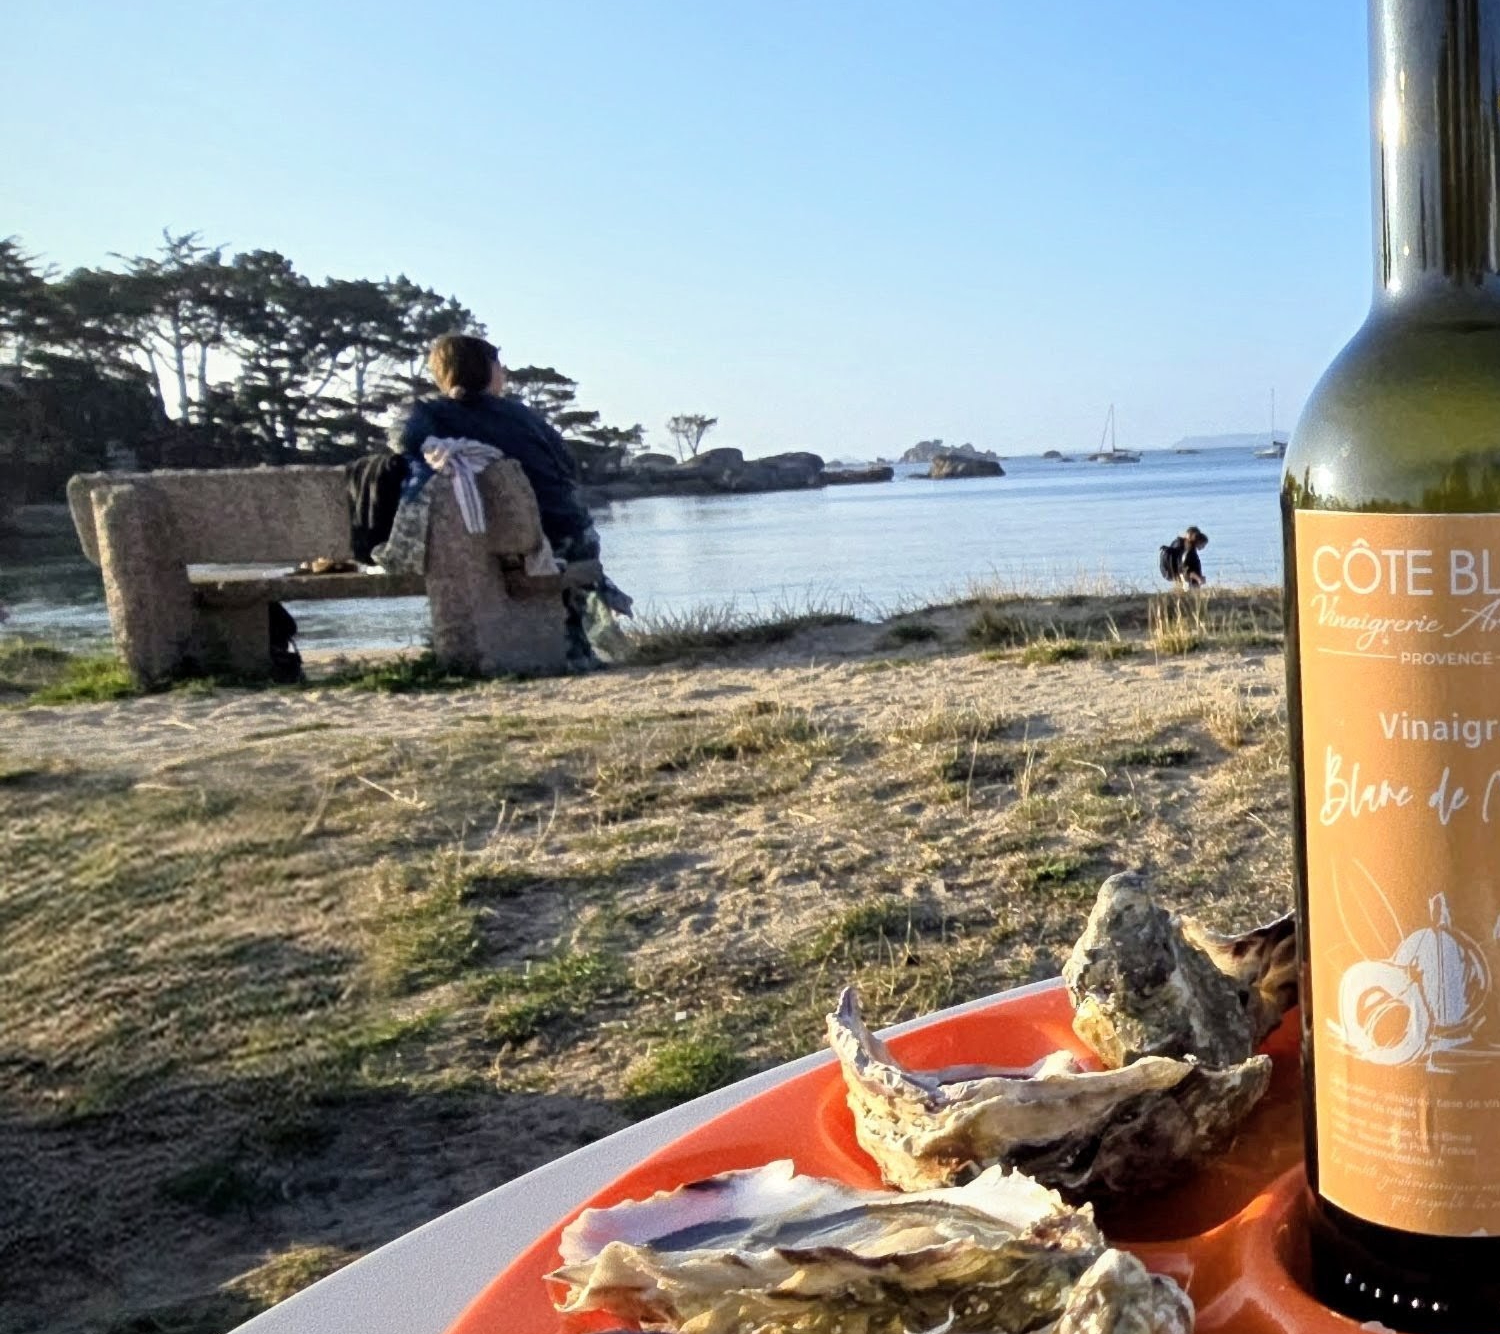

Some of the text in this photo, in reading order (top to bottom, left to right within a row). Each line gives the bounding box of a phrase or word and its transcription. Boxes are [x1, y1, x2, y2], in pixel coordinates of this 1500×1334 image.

[1312, 538, 1433, 595] CÔTE
[1310, 593, 1444, 651] Vinaigrerie
[1400, 651, 1494, 666] PROVENCE
[1319, 745, 1414, 826] Blanc
[1428, 767, 1470, 825] de
